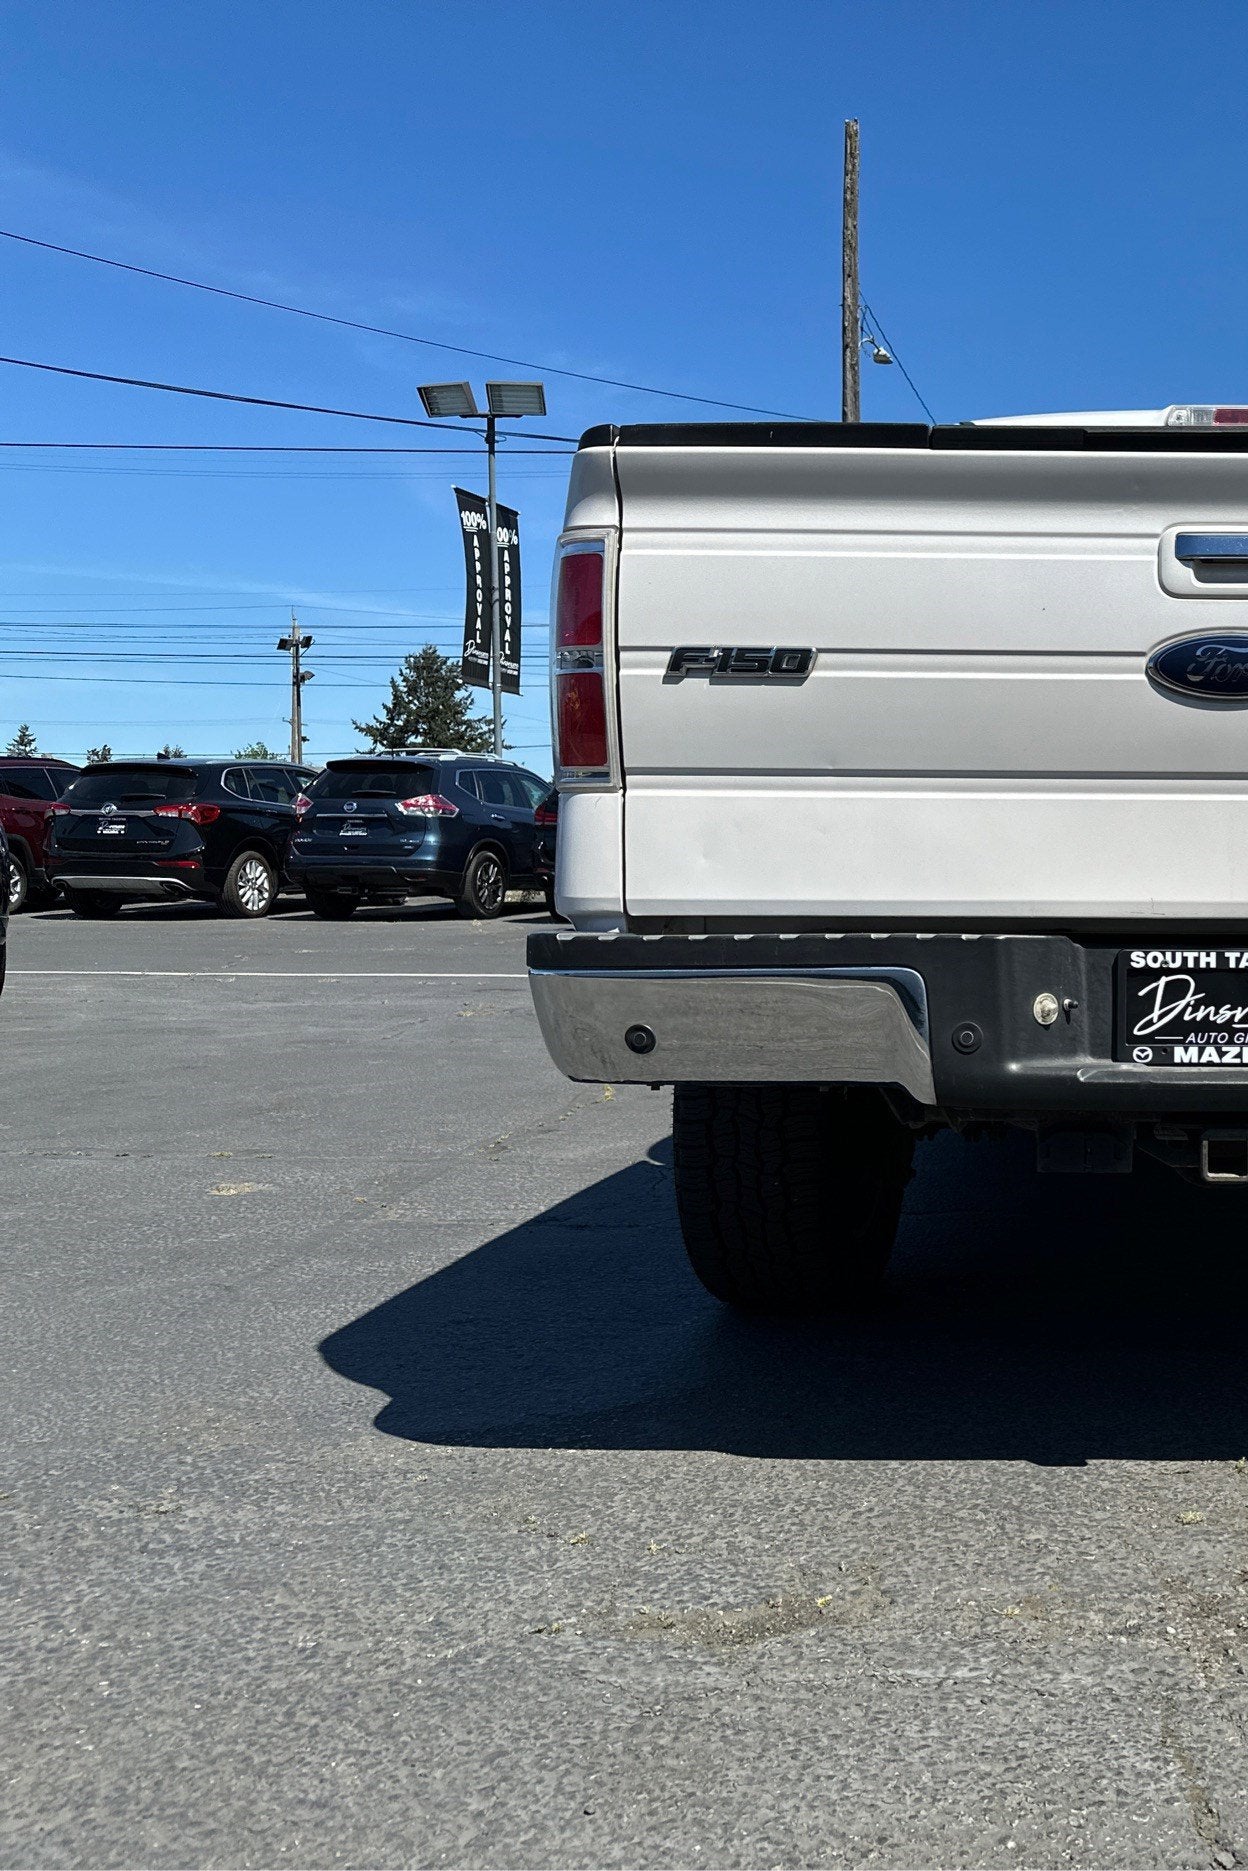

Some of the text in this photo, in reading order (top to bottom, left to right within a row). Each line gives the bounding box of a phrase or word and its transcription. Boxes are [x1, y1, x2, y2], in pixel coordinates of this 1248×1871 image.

[461, 510, 487, 530] 100%
[496, 526, 518, 546] 00%
[473, 534, 483, 645] APPROVAL
[503, 549, 512, 655] APPROVAL
[1130, 950, 1217, 969] SOUTH
[1185, 1032, 1229, 1044] AUTO
